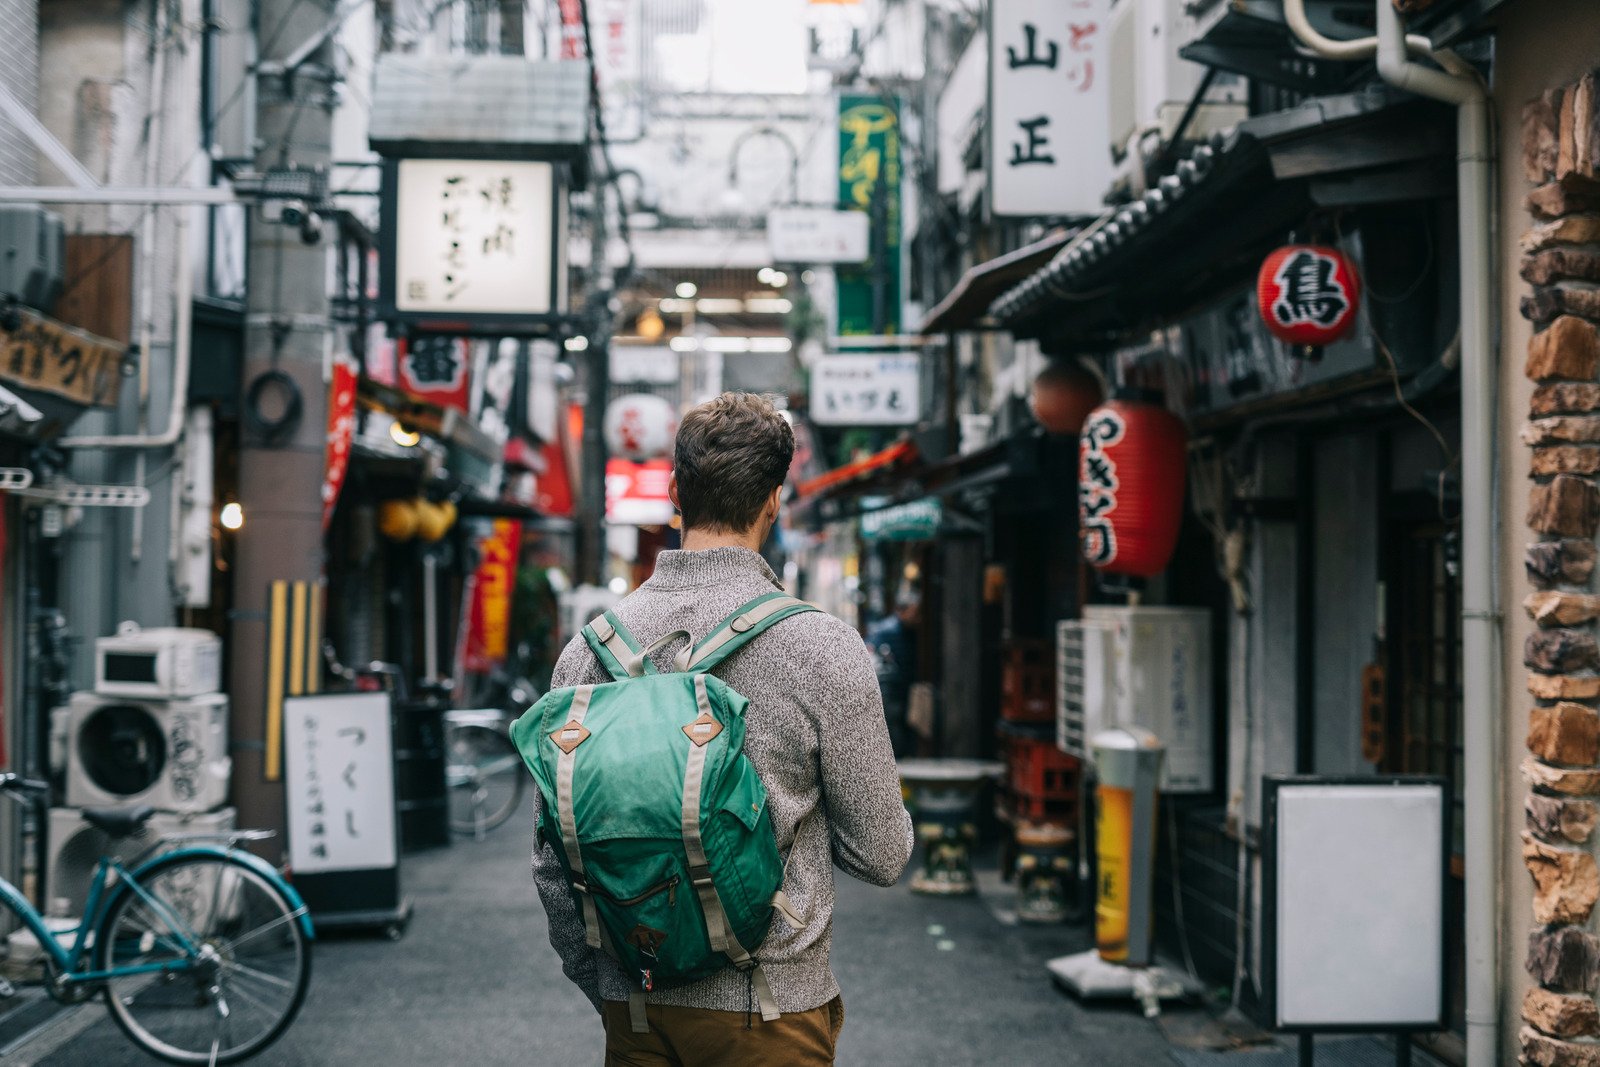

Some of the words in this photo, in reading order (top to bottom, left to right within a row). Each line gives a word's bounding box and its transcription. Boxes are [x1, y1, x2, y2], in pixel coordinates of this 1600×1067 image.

[1006, 22, 1058, 167] 山正
[1276, 250, 1347, 326] 鳥
[336, 726, 367, 838] つくし
